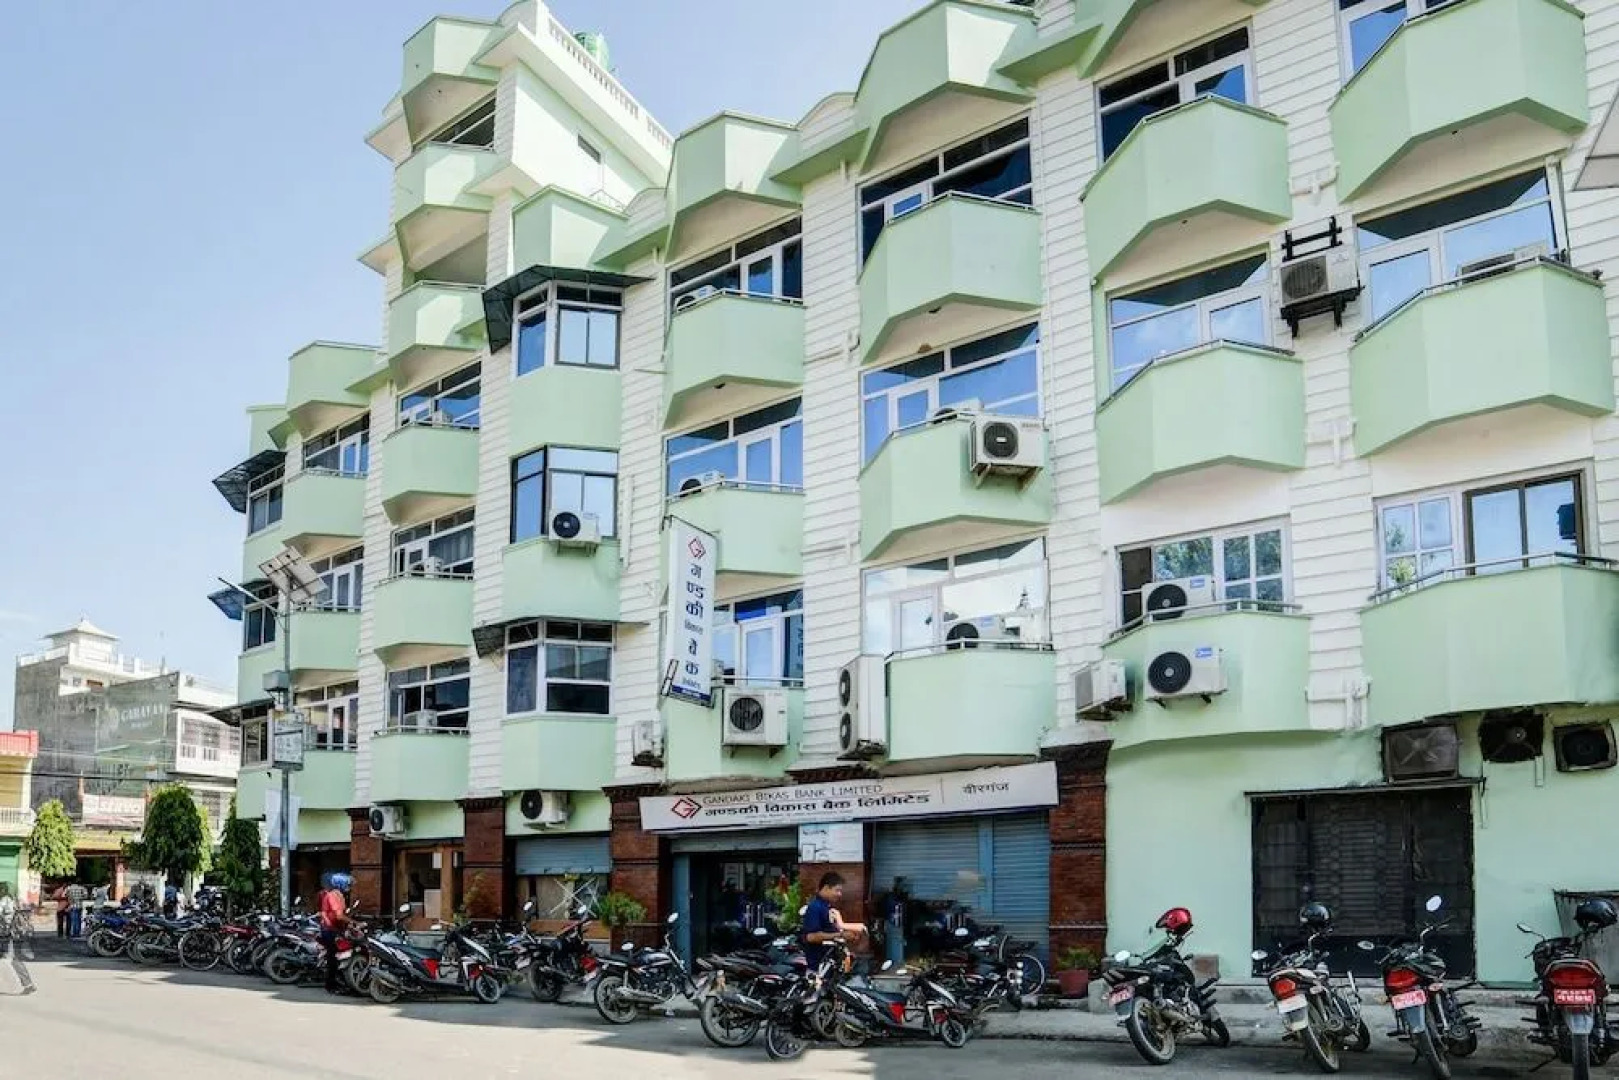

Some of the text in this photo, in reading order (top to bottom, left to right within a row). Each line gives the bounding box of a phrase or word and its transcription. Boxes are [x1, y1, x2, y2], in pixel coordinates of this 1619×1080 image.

[703, 784, 883, 804] GANDAKI BIKAS BANK LIMITED
[705, 804, 759, 816] गण्डकी
[765, 801, 817, 812] विकास
[858, 794, 930, 807] लिमिटेड
